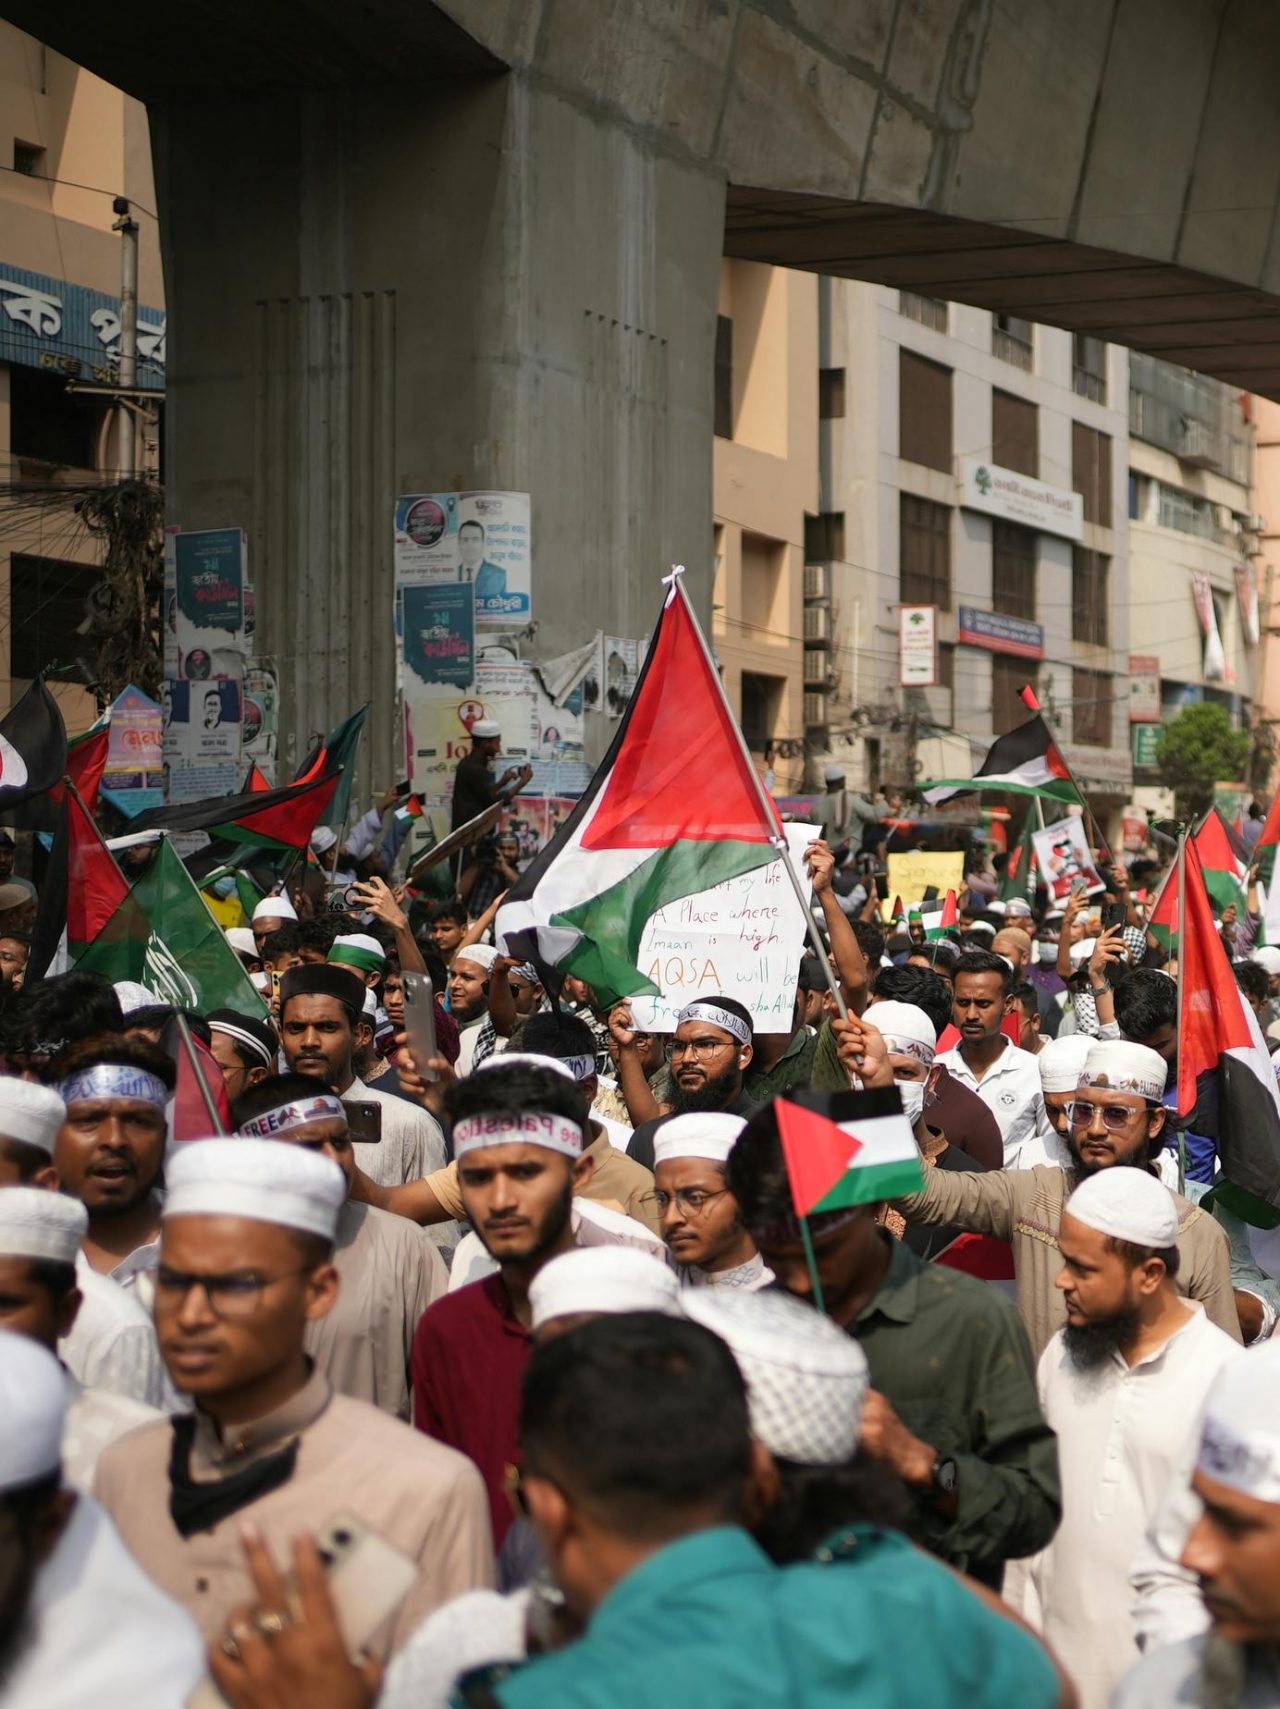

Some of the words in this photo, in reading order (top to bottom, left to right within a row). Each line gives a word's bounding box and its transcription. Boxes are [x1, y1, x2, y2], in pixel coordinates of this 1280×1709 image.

[680, 898, 720, 924] Place
[707, 934, 718, 946] is
[647, 955, 723, 991] AQSA
[735, 957, 770, 984] will
[783, 957, 799, 988] be
[243, 1113, 279, 1138] FREE
